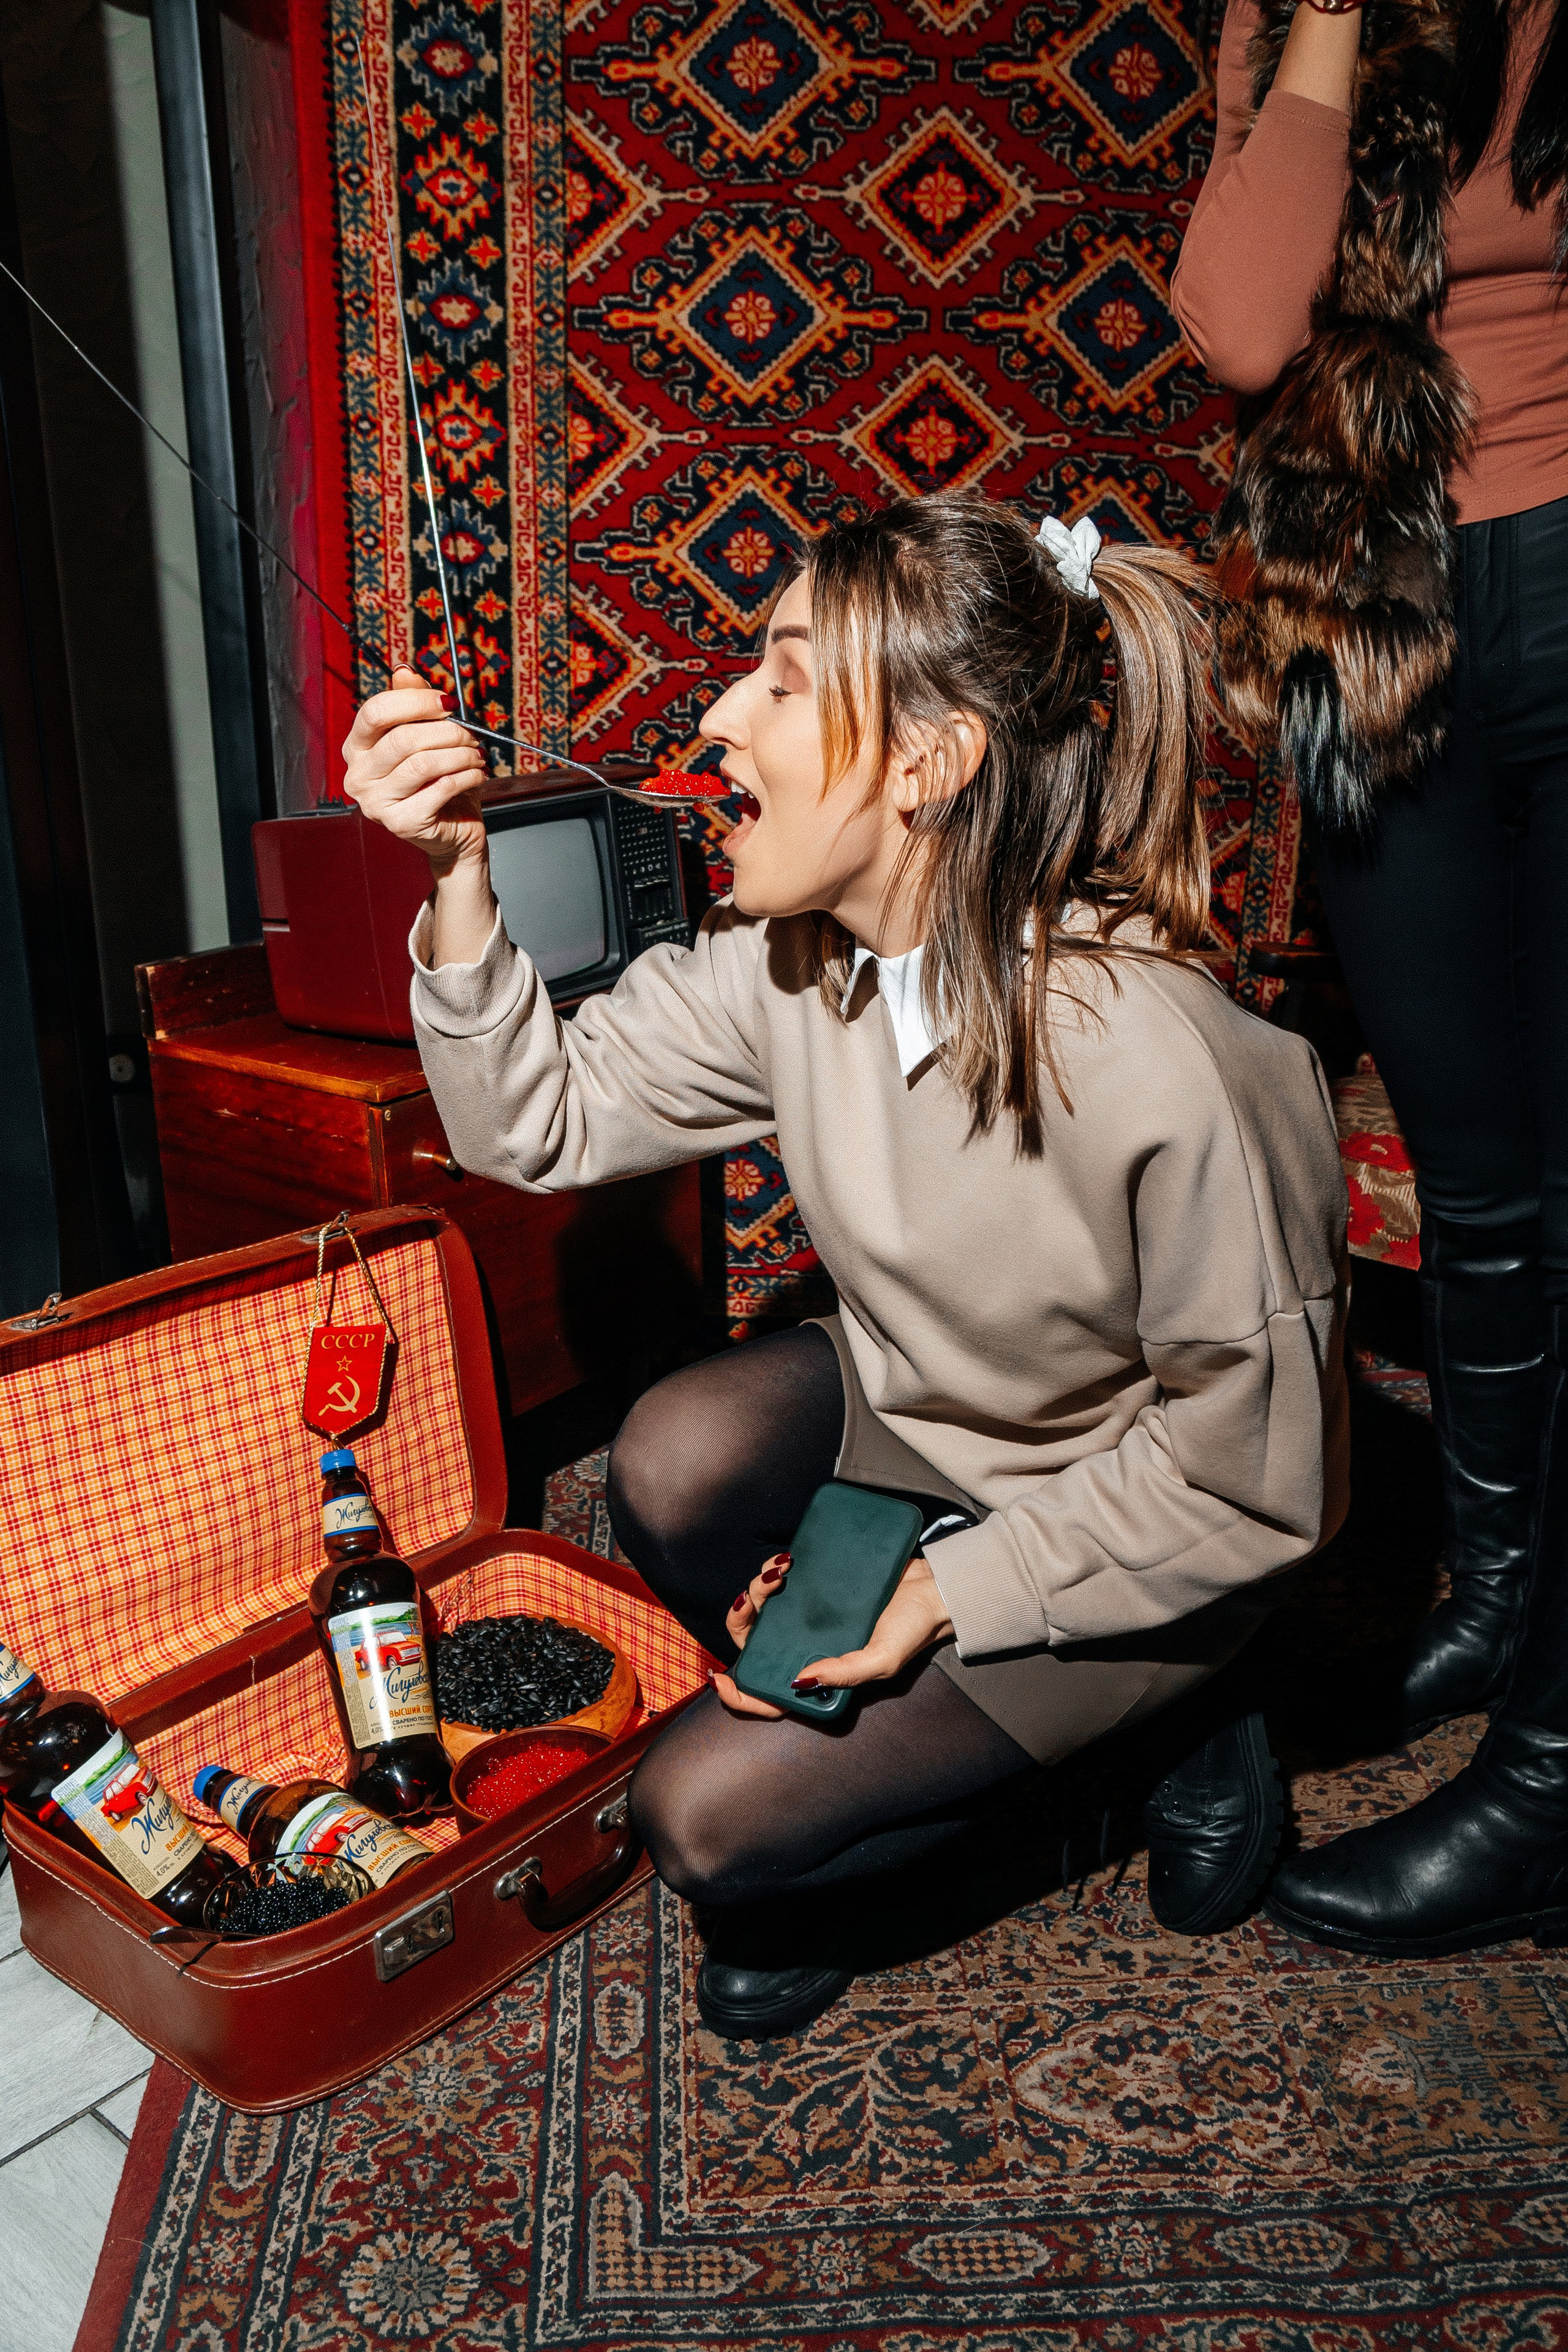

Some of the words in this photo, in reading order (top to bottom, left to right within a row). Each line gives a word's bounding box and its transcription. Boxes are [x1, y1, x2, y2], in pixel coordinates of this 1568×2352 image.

[321, 1333, 375, 1349] СССР
[389, 1705, 421, 1718] ВЫСШИЙ
[392, 1717, 417, 1725] СВАРЕНО
[368, 1843, 399, 1872] ВЫСШИЙ
[376, 1852, 399, 1873] СВАРЕНО
